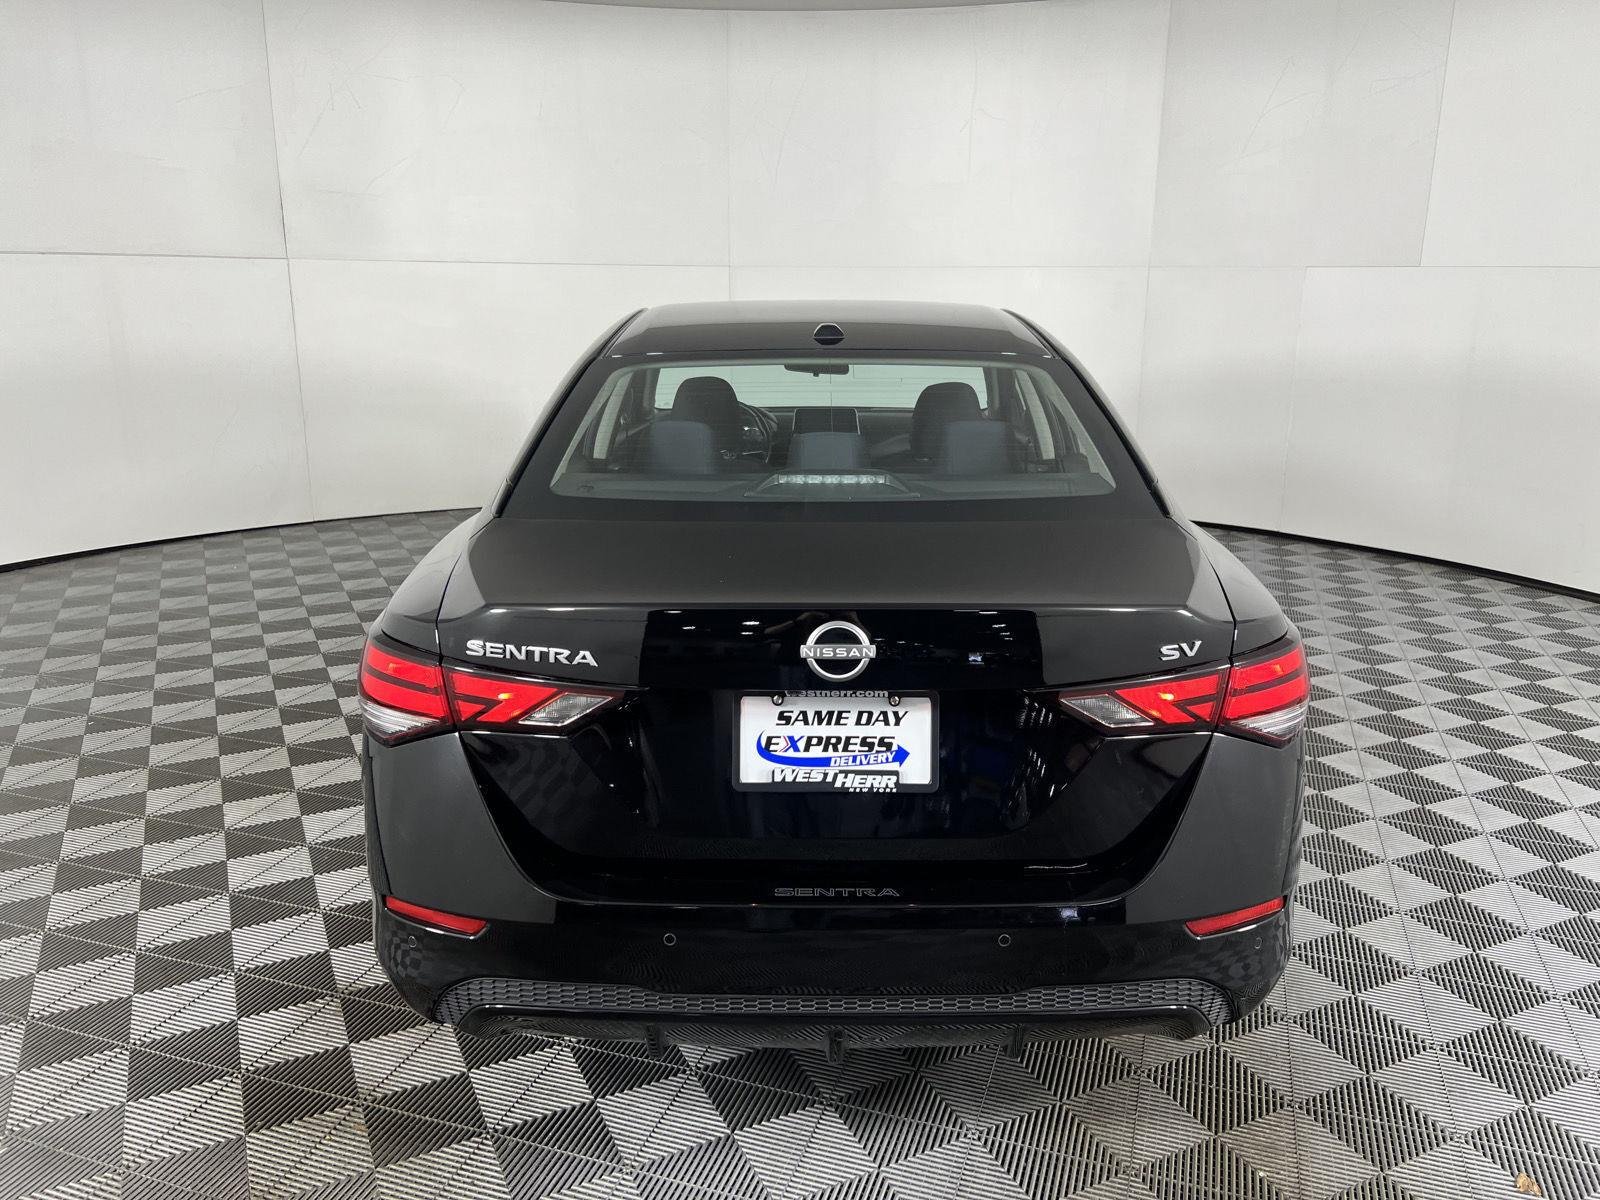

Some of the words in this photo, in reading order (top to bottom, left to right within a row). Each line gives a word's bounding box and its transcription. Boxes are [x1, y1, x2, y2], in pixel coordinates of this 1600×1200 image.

[465, 639, 598, 667] SENTRA
[802, 647, 874, 657] NISSAN
[1160, 640, 1202, 660] SV
[775, 710, 851, 726] SAME
[855, 710, 909, 726] DAY
[764, 735, 895, 752] EXPRESS
[830, 751, 896, 767] DELIVERY
[774, 887, 900, 897] SENTRA
